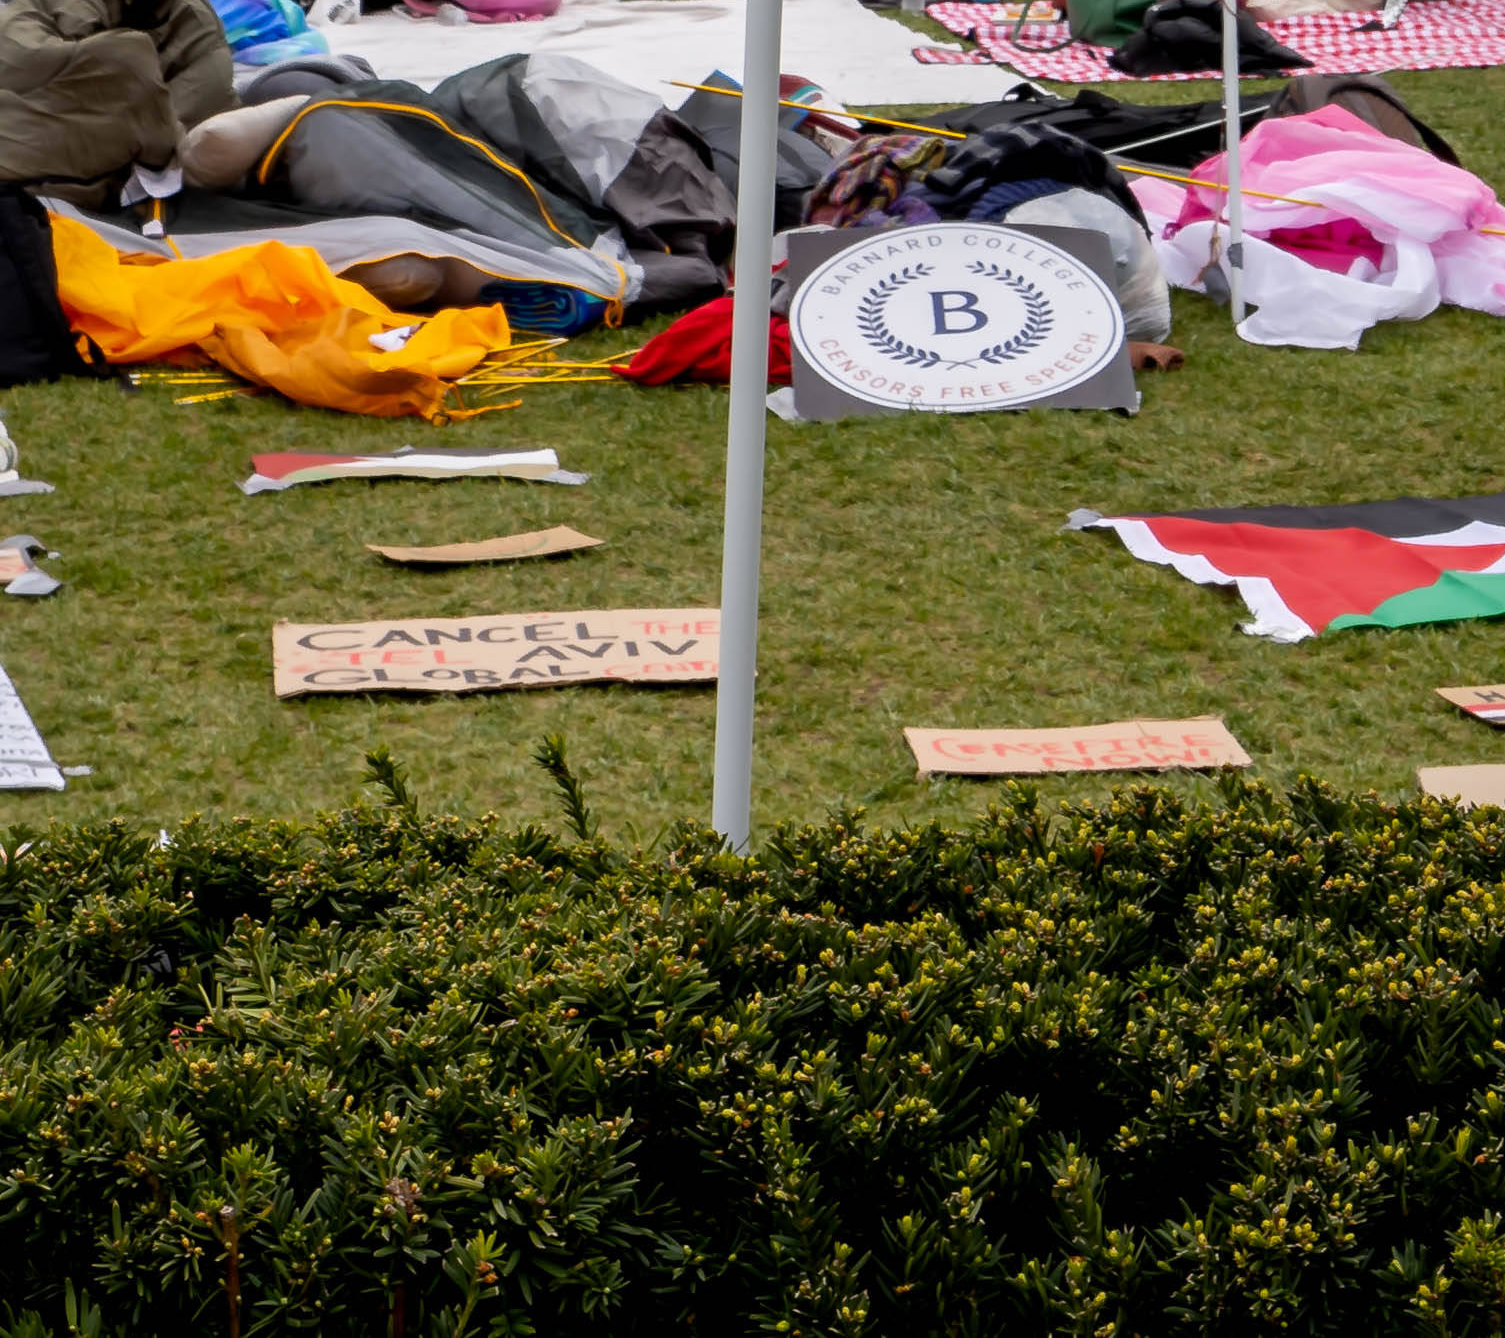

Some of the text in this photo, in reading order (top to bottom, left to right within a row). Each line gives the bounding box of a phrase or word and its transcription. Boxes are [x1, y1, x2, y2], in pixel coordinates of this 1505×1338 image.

[821, 233, 1088, 297] BARNARD COLLEGE
[927, 289, 989, 337] B
[818, 331, 1100, 400] CENSORS FREE SPEECH
[297, 620, 720, 651] CANCEL THE
[515, 639, 700, 664] AVIV
[302, 664, 600, 687] GLOBAL
